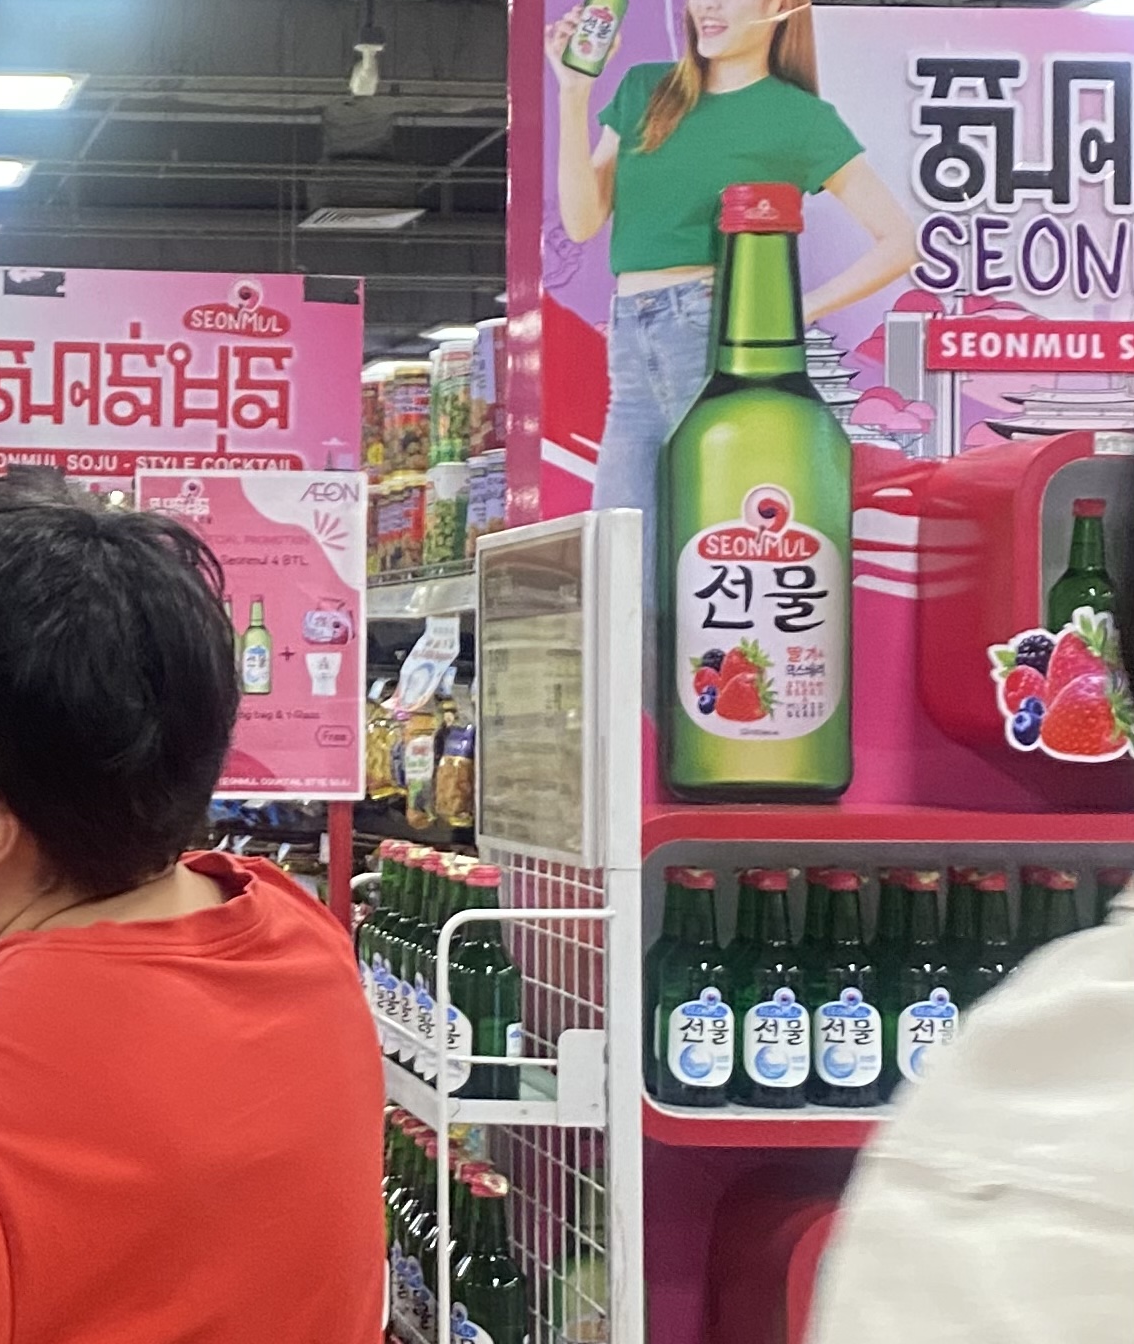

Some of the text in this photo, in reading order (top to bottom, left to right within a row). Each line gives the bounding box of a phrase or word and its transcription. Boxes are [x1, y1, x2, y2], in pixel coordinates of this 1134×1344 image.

[190, 309, 284, 333] SEONMUL
[941, 331, 1105, 360] SEONMUL
[67, 454, 118, 471] SOJU
[136, 456, 196, 470] STYLE
[705, 534, 811, 558] SEONMUL
[694, 564, 829, 633] 선물
